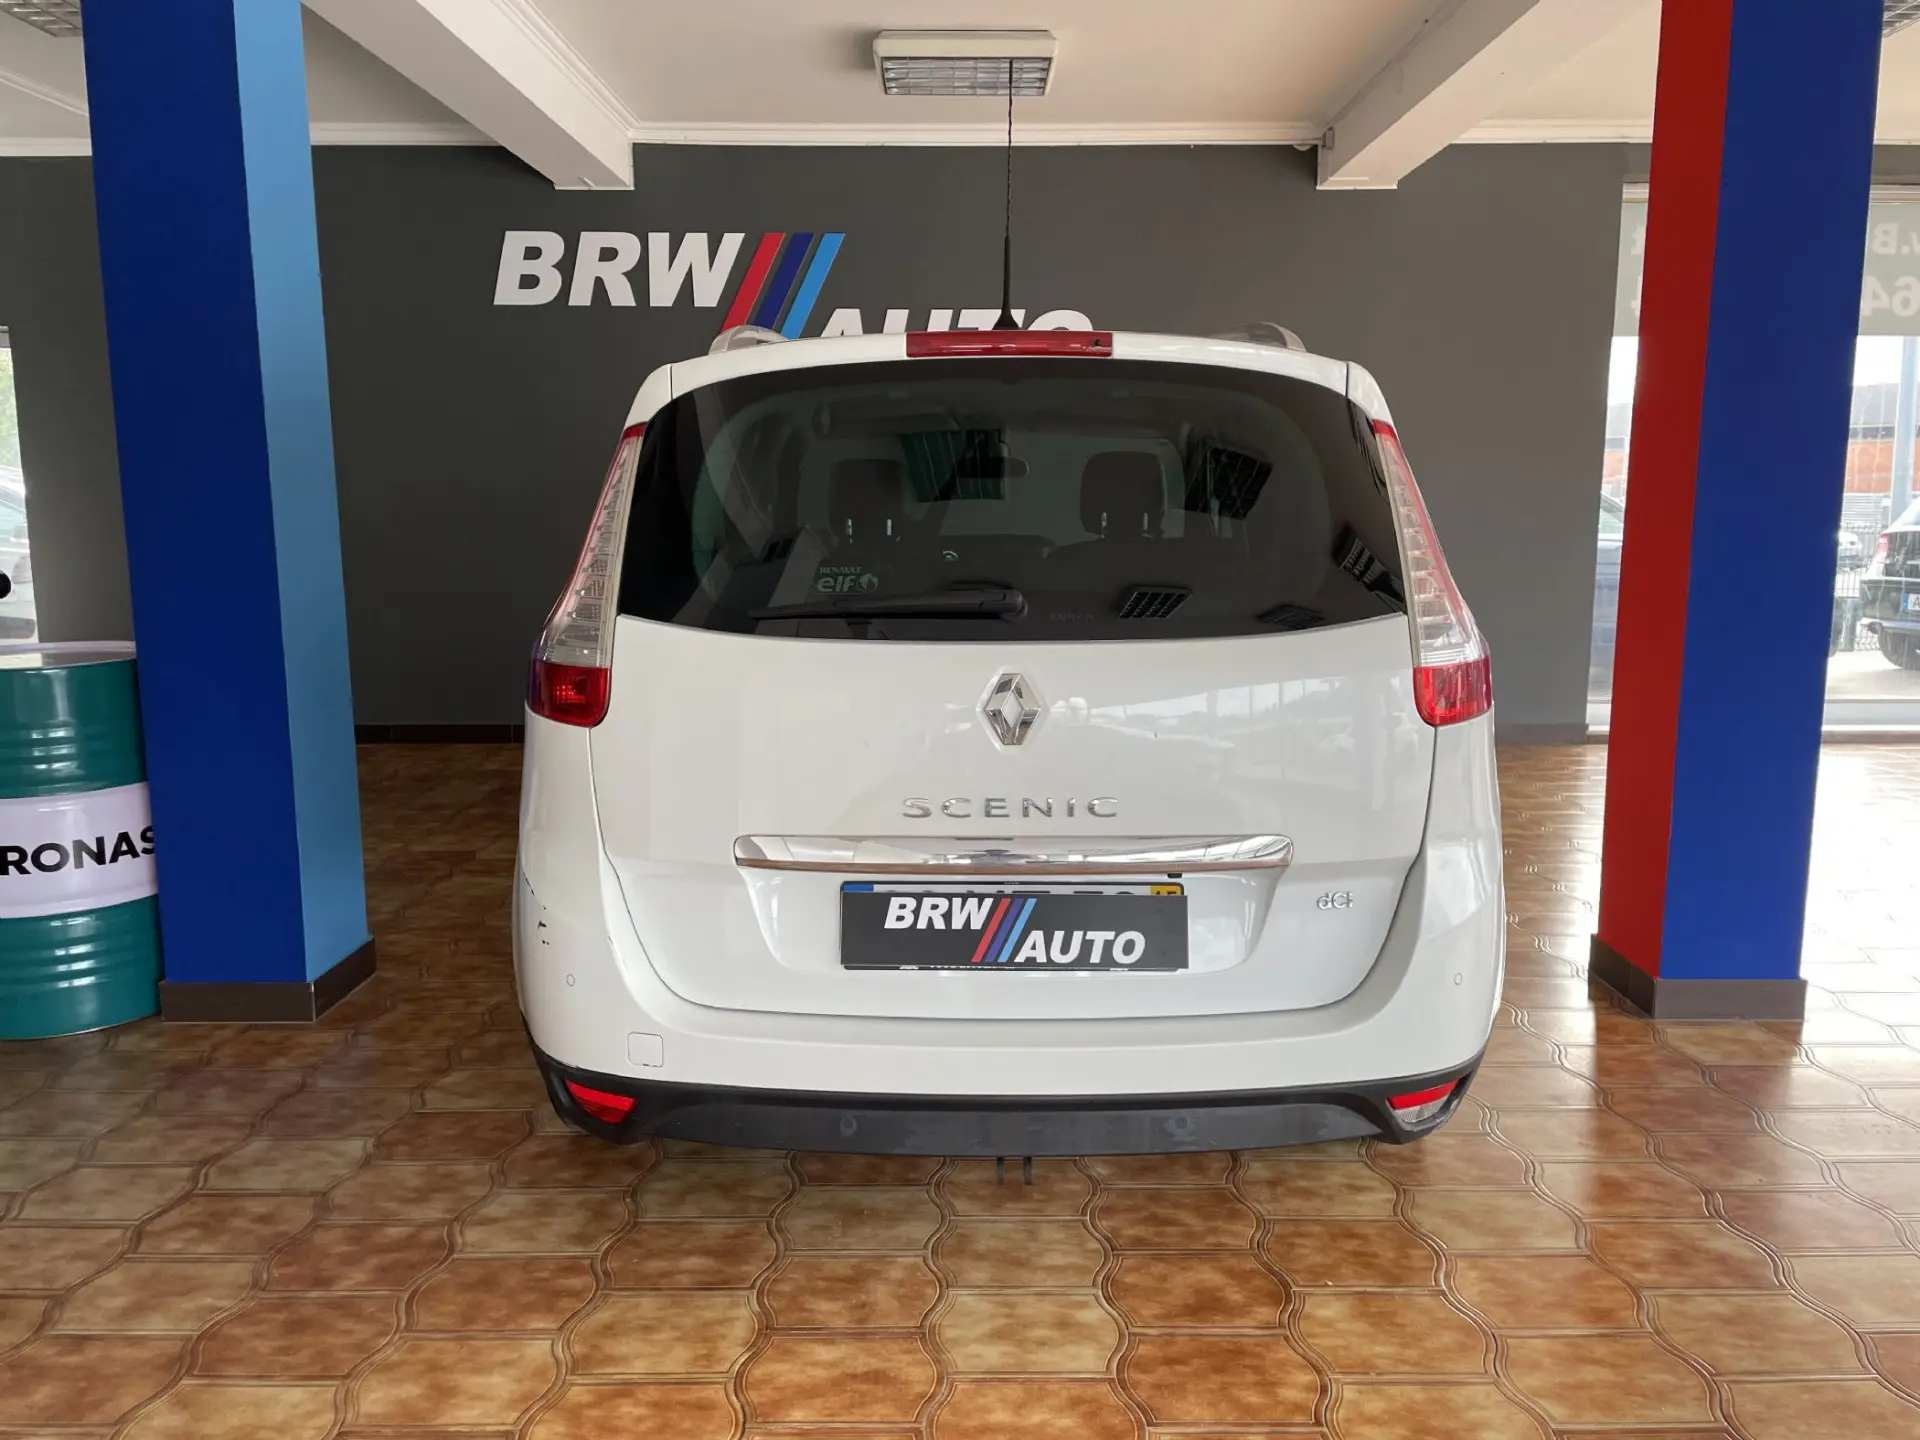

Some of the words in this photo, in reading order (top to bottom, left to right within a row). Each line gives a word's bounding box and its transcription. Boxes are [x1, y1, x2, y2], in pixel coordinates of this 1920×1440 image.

[493, 231, 745, 307] BRW
[820, 565, 862, 575] RENAULT
[902, 796, 1119, 819] SCENIC
[883, 896, 994, 930] BRW
[1014, 930, 1146, 964] AUTO
